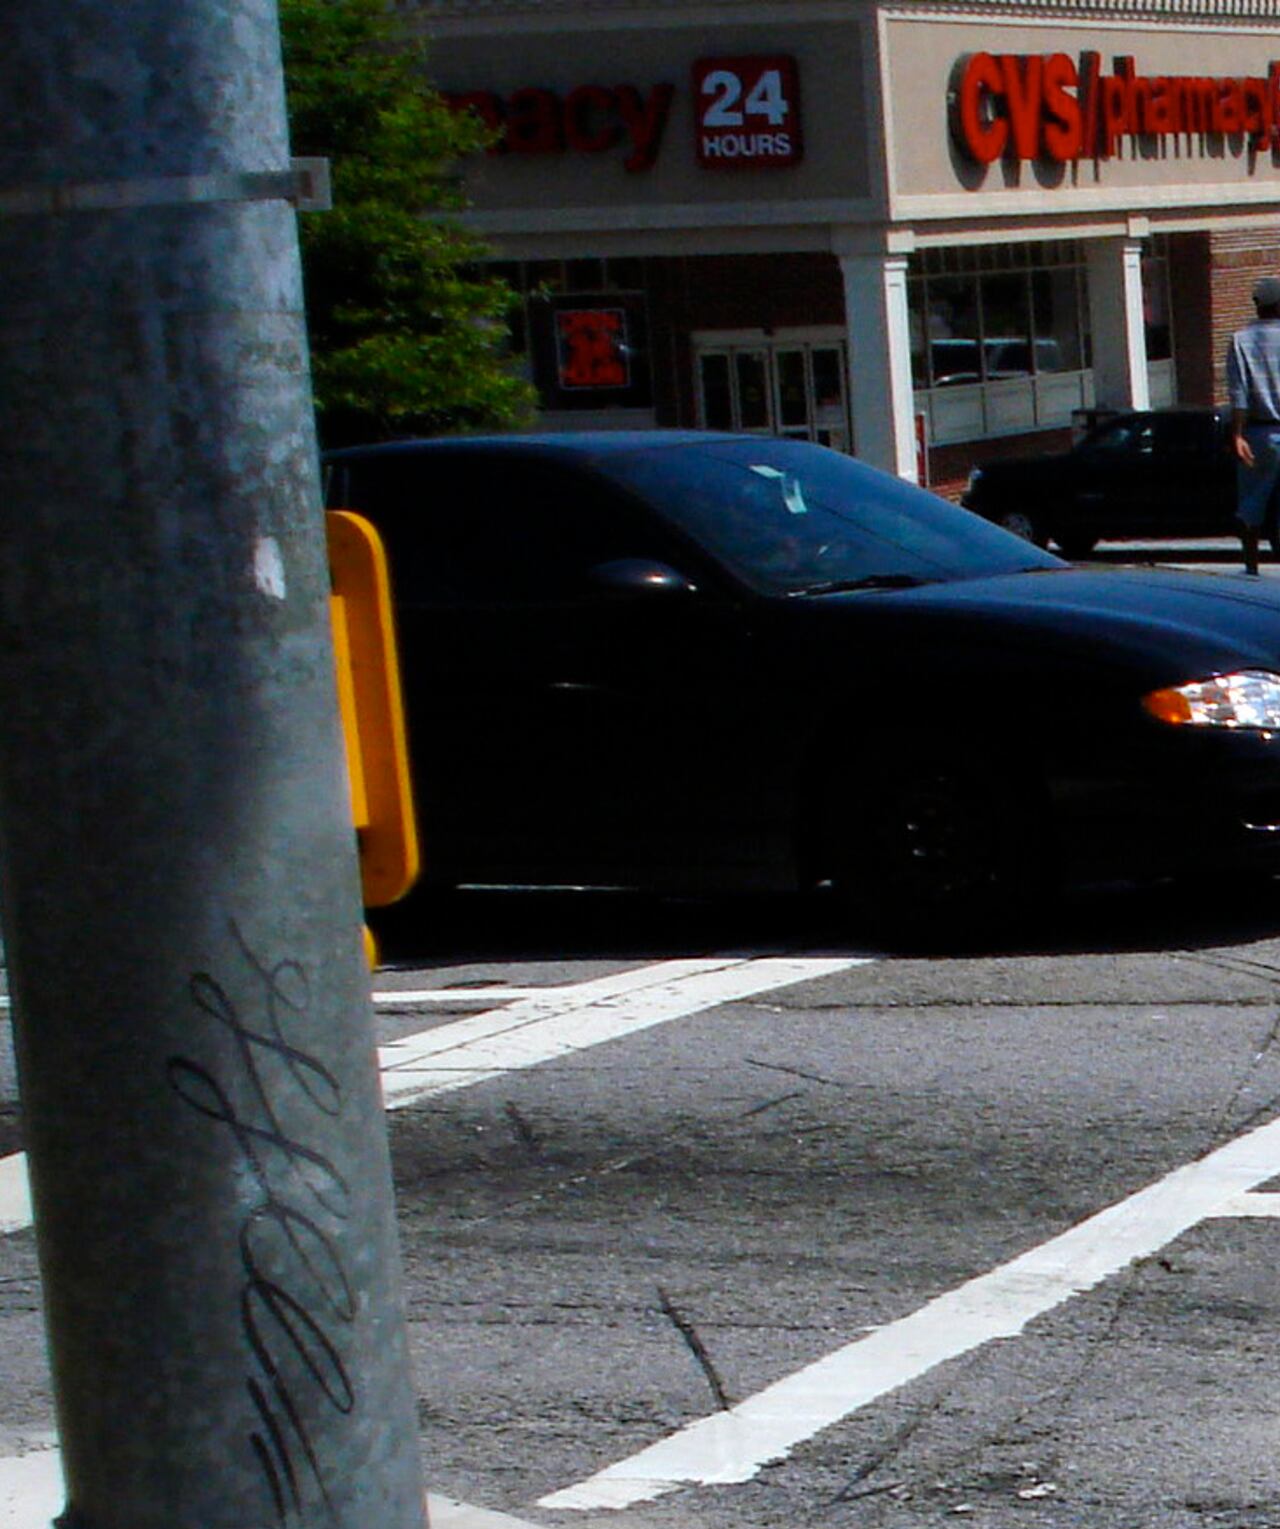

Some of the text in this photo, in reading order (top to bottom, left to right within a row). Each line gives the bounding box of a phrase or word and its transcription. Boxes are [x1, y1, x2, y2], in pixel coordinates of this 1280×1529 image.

[702, 69, 788, 128] 24
[960, 51, 1272, 164] CVS/pharmacy
[702, 134, 792, 158] HOURS
